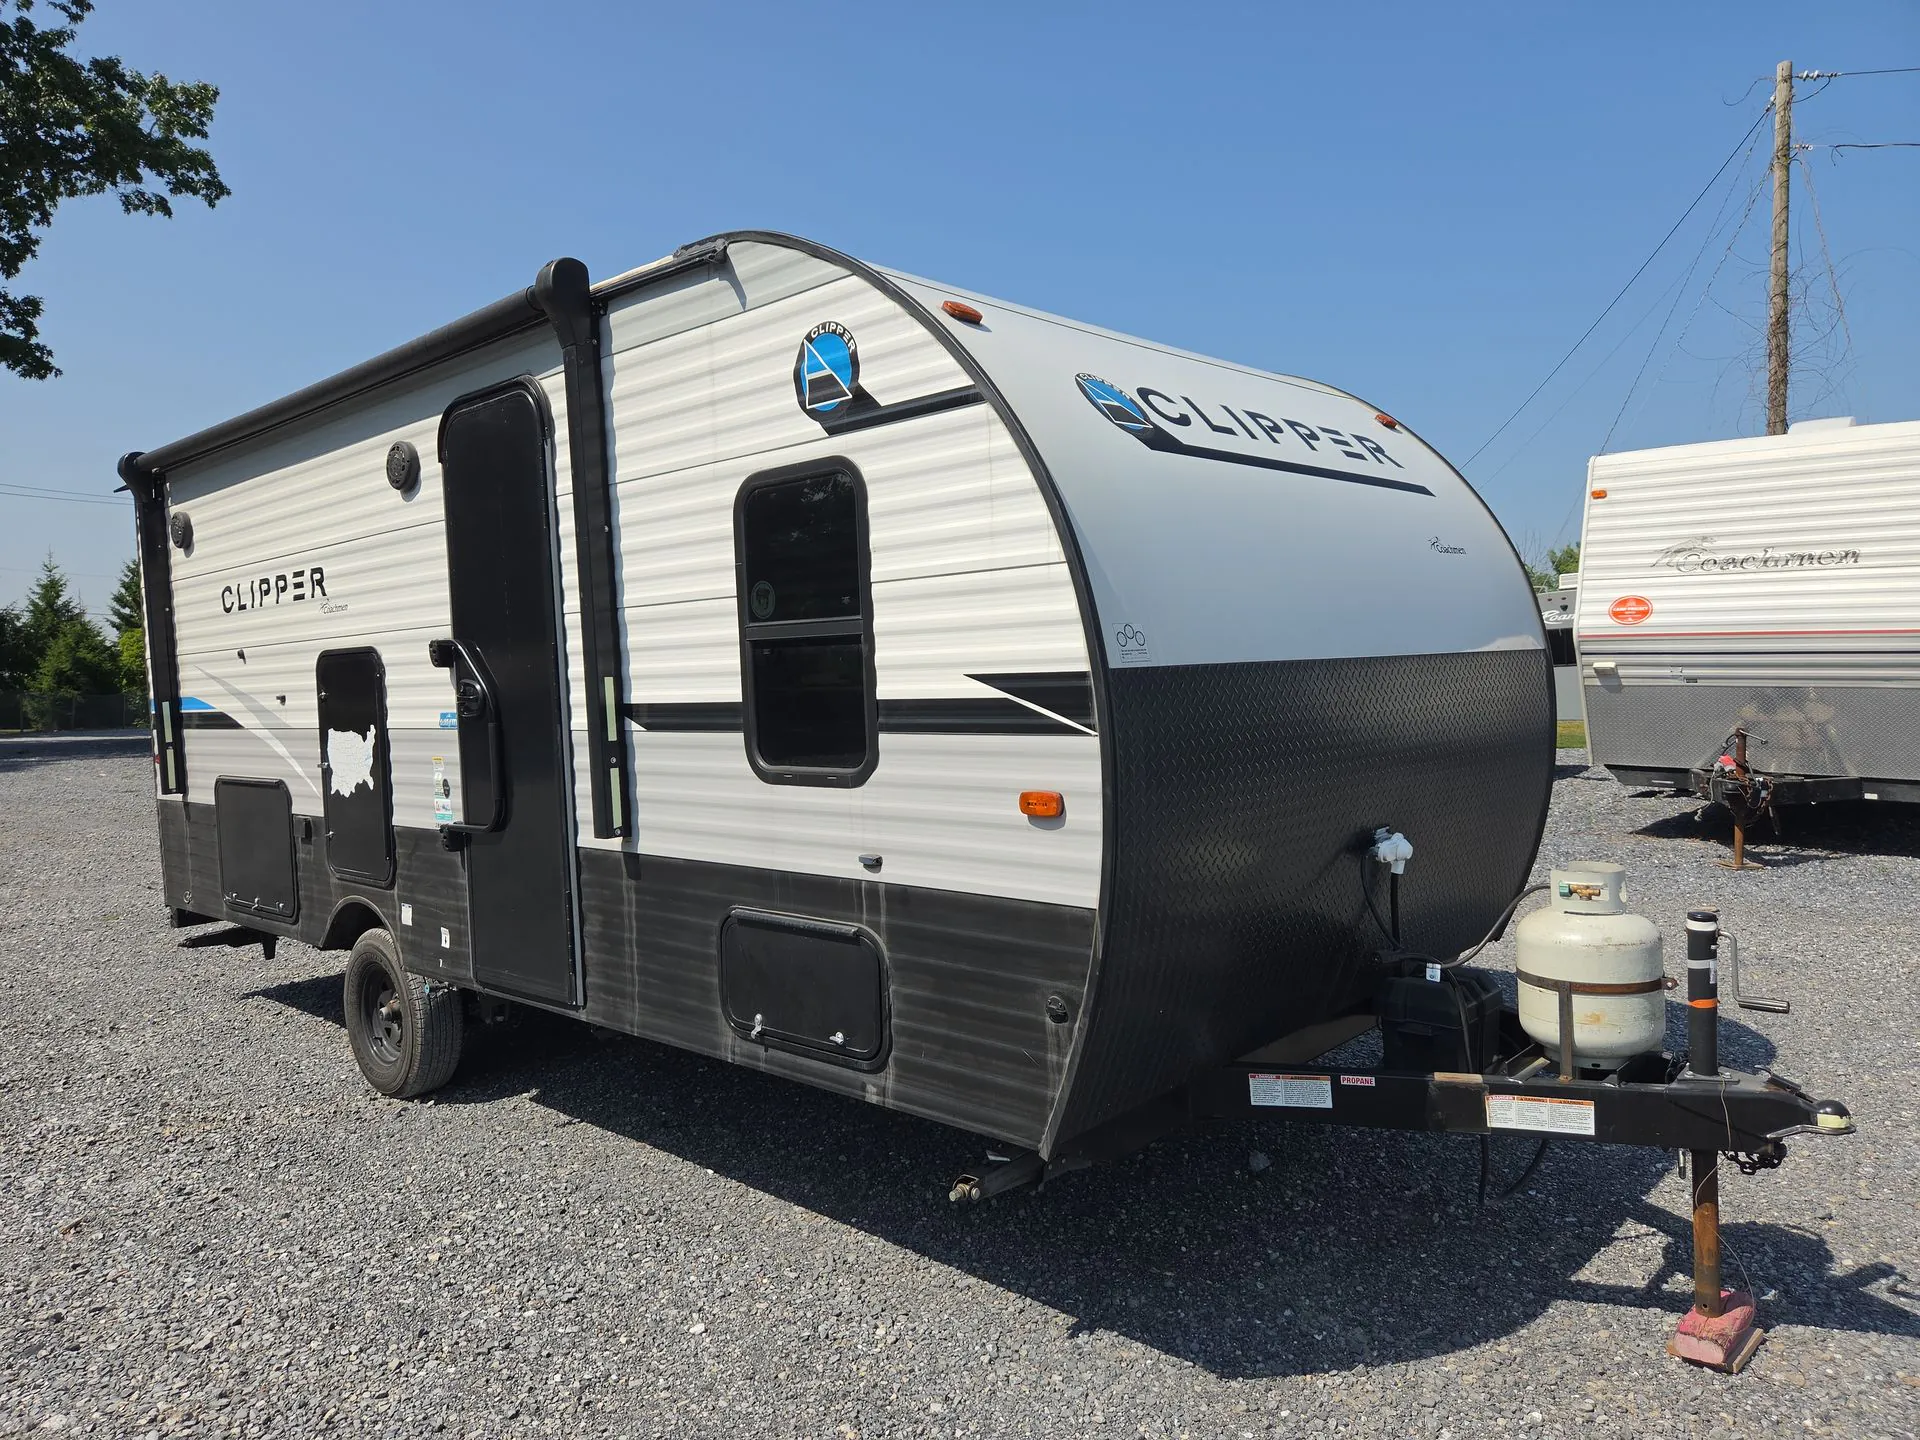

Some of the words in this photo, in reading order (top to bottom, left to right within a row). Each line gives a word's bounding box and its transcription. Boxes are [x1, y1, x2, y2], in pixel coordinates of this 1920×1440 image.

[810, 322, 856, 353] CLIPPER
[1136, 386, 1405, 469] CLIPPER
[1675, 546, 1861, 573] Coachmen
[221, 566, 328, 614] CLIPPER
[1341, 1076, 1374, 1085] PROPANE
